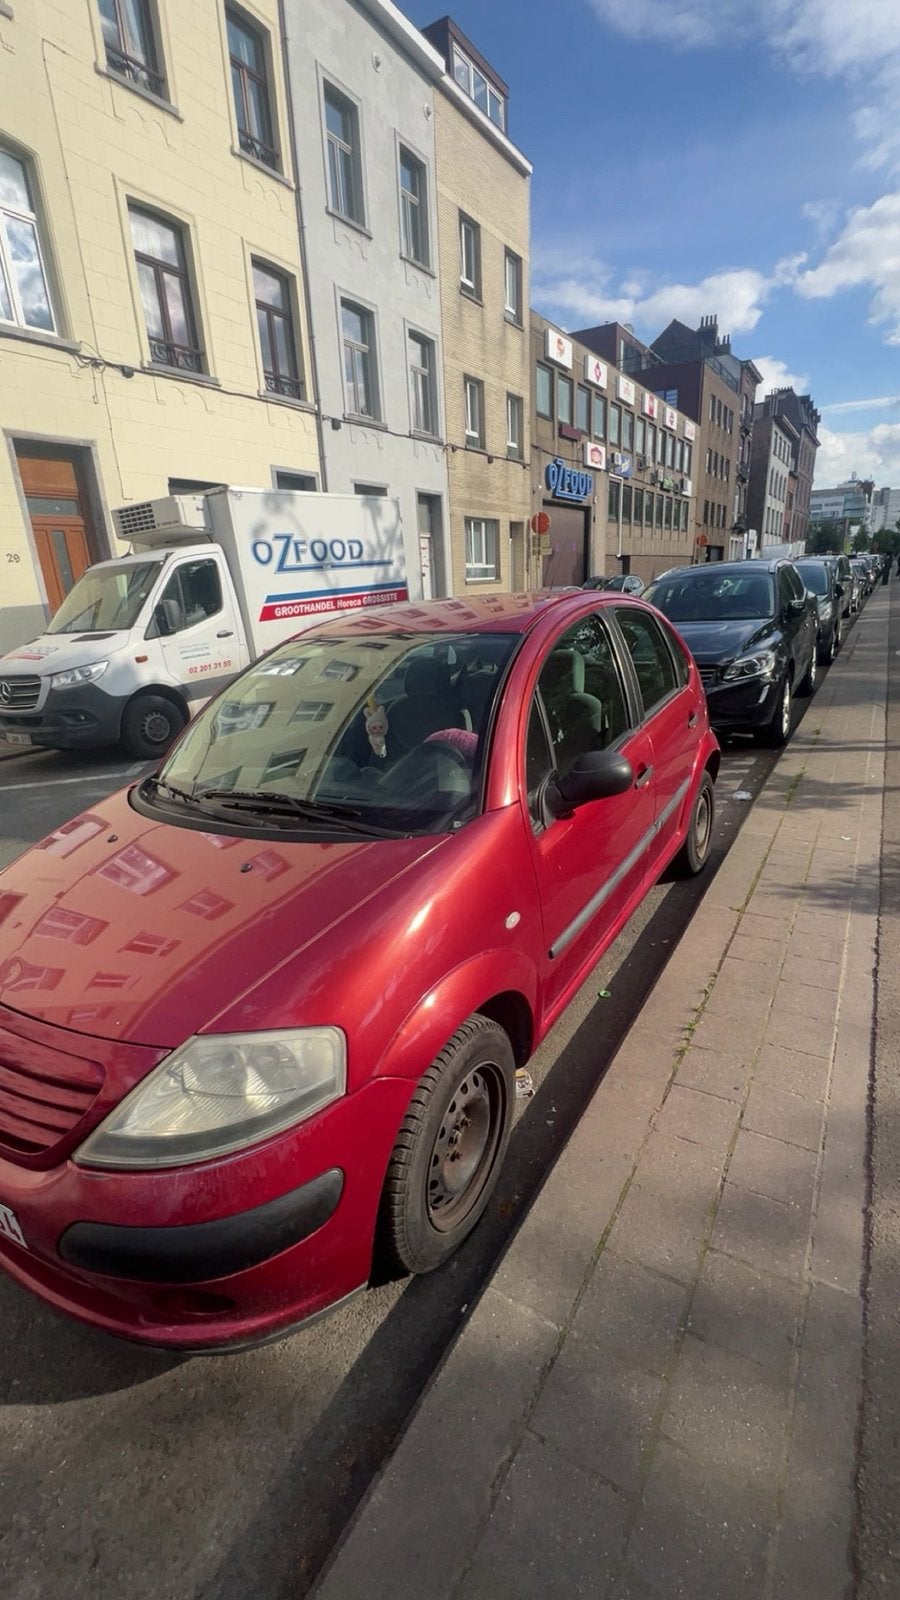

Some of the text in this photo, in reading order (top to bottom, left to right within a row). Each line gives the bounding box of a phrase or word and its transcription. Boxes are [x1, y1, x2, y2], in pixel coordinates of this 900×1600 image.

[546, 458, 593, 502] OZFOOD
[6, 553, 20, 563] 29
[251, 533, 393, 574] OZFOOD
[274, 592, 398, 616] GROOTHANDEL Horeca GROSSISTE
[189, 666, 198, 674] 02
[200, 664, 212, 673] 201
